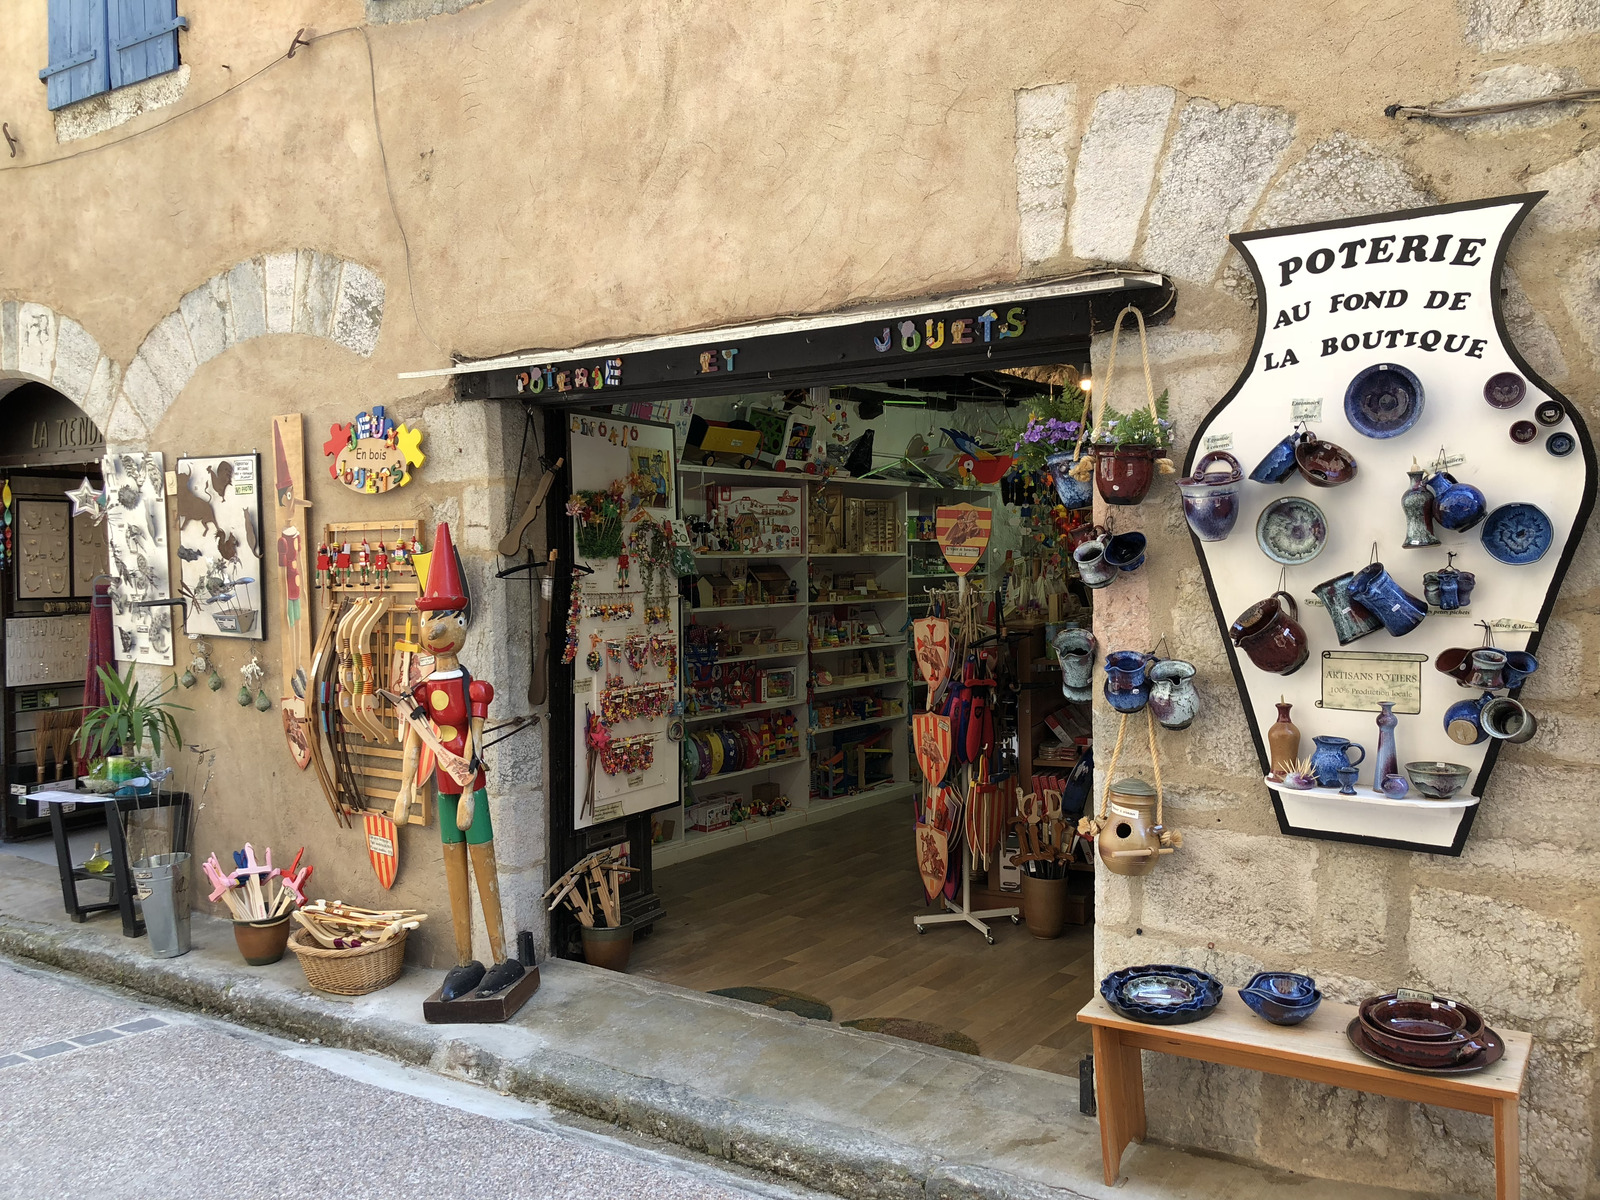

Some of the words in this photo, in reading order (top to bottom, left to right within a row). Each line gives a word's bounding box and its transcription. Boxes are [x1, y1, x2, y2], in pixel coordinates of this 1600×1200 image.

[1278, 234, 1487, 287] POTERIE
[1273, 301, 1311, 330] AU
[1329, 289, 1408, 313] FOND
[1423, 290, 1472, 310] DE
[515, 358, 622, 394] POTERIE
[700, 348, 738, 373] ET
[873, 307, 1027, 353] JOUETS
[1263, 348, 1300, 372] LA
[1320, 328, 1488, 359] BOUTIQUE
[32, 420, 49, 449] LA
[57, 416, 103, 448] TIEND
[347, 414, 399, 452] JEUX
[356, 447, 367, 460] En
[369, 448, 387, 460] bois
[336, 460, 404, 494] JOUETS
[1325, 670, 1374, 681] ARTISANS
[1376, 672, 1418, 683] POTIERS
[1330, 686, 1350, 694] 100%
[1351, 687, 1390, 697] Production
[1391, 688, 1413, 698] locale
